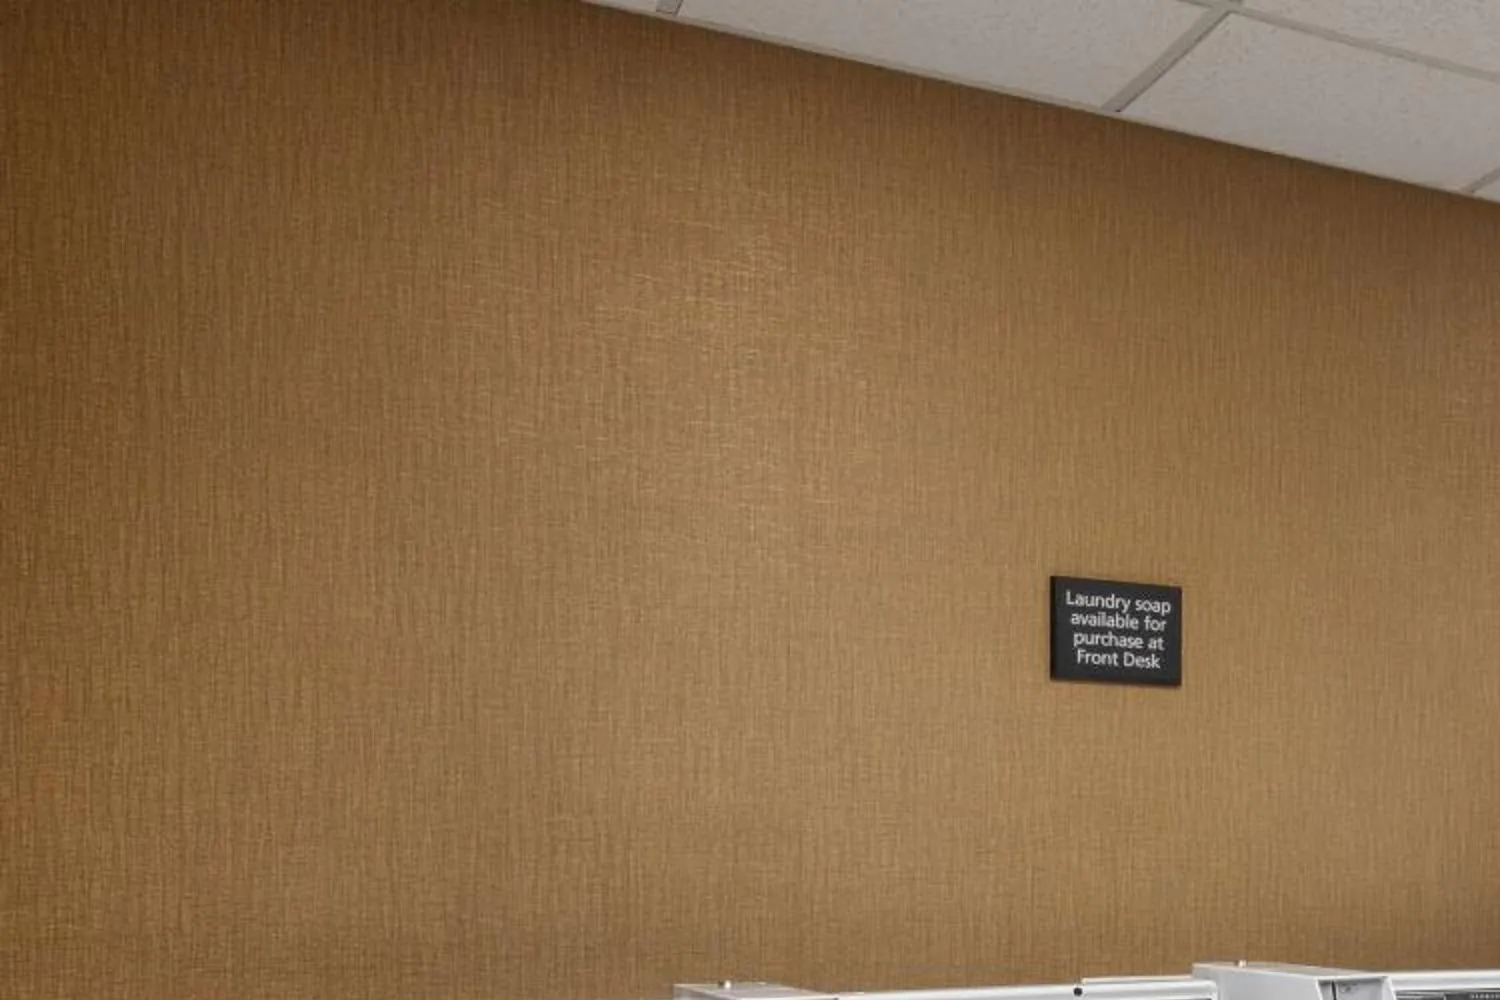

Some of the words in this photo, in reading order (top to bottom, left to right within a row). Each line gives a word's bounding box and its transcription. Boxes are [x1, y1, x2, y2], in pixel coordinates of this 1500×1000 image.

[1066, 590, 1130, 613] Laundry
[1135, 599, 1171, 615] soap
[1071, 612, 1139, 629] available
[1144, 616, 1167, 631] for
[1073, 632, 1143, 649] purchase
[1148, 638, 1164, 650] at
[1077, 650, 1119, 667] Front
[1124, 652, 1160, 669] Desk
